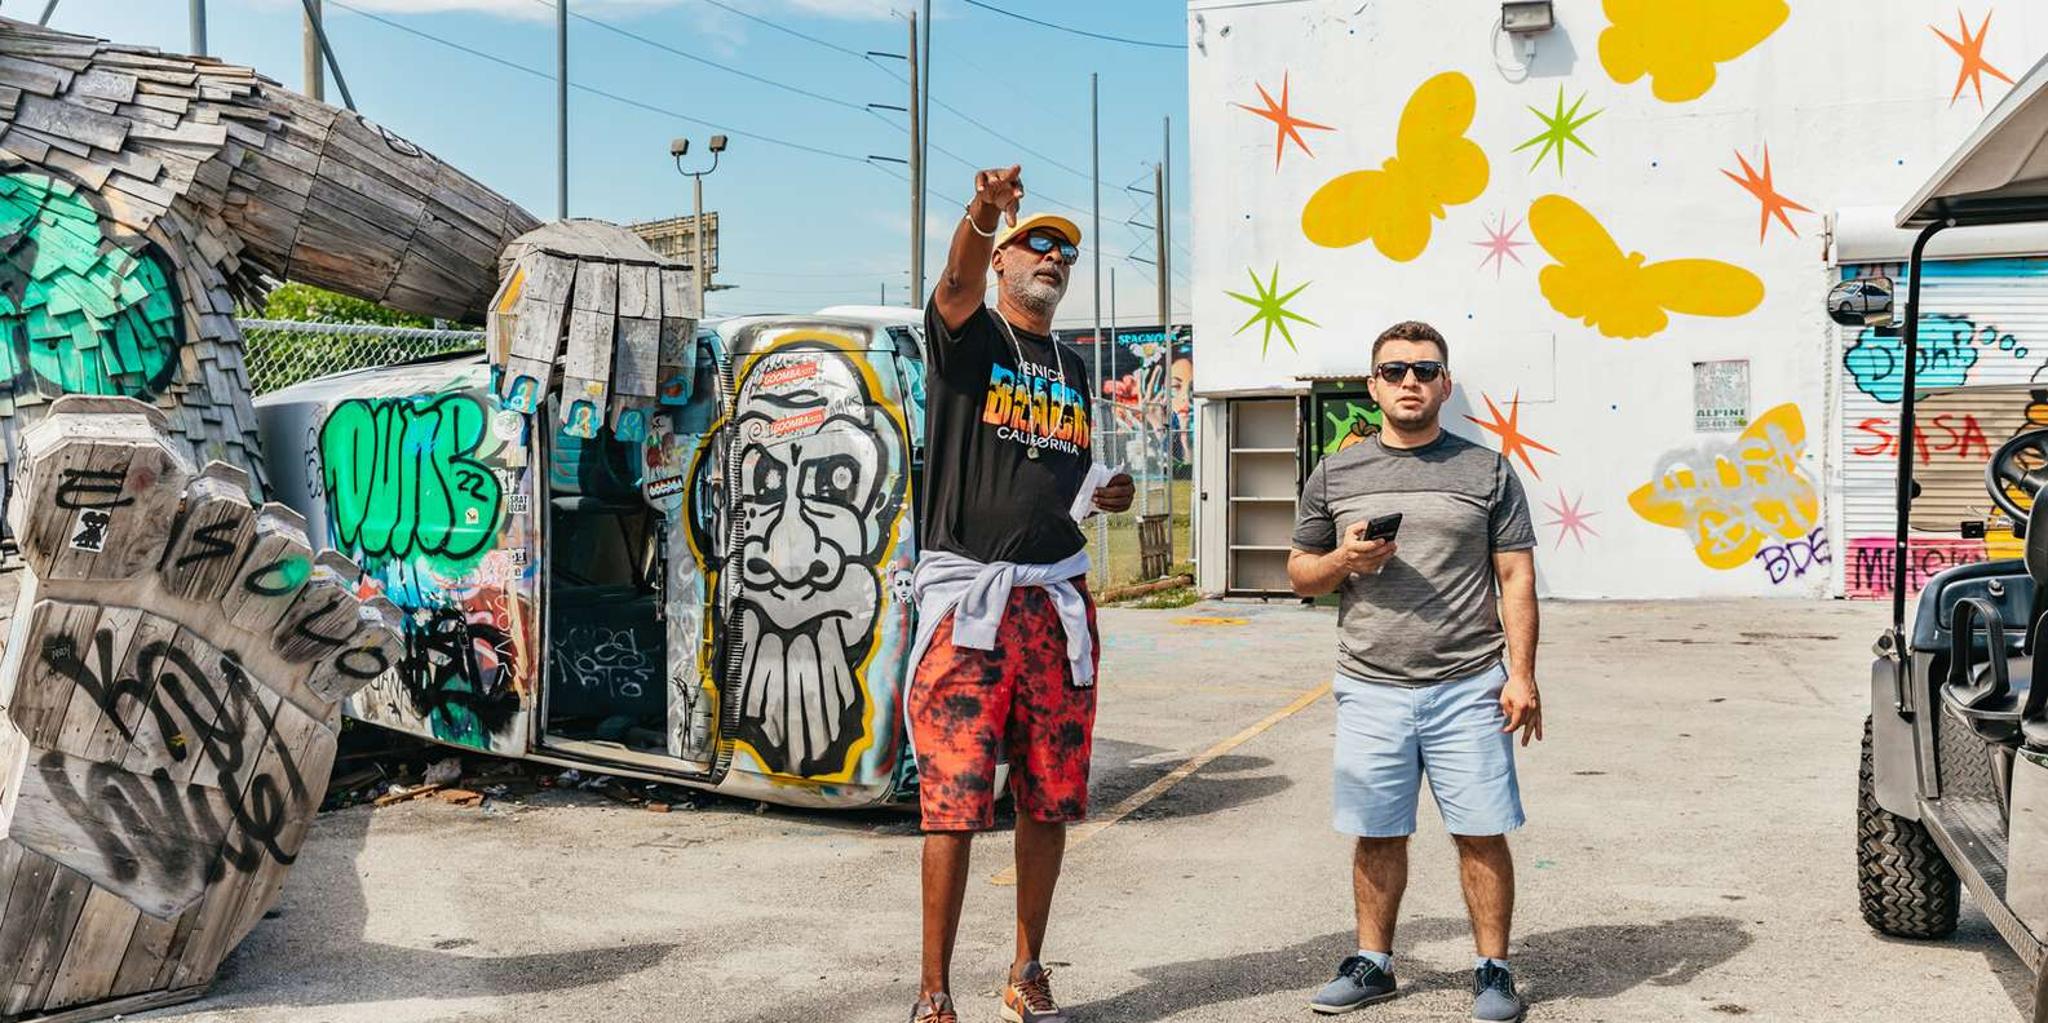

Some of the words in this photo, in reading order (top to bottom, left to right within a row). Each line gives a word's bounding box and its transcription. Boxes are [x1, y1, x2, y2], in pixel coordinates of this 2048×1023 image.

[981, 362, 1092, 449] BEACH
[997, 426, 1079, 456] CALIFORNIA
[455, 469, 490, 502] 22
